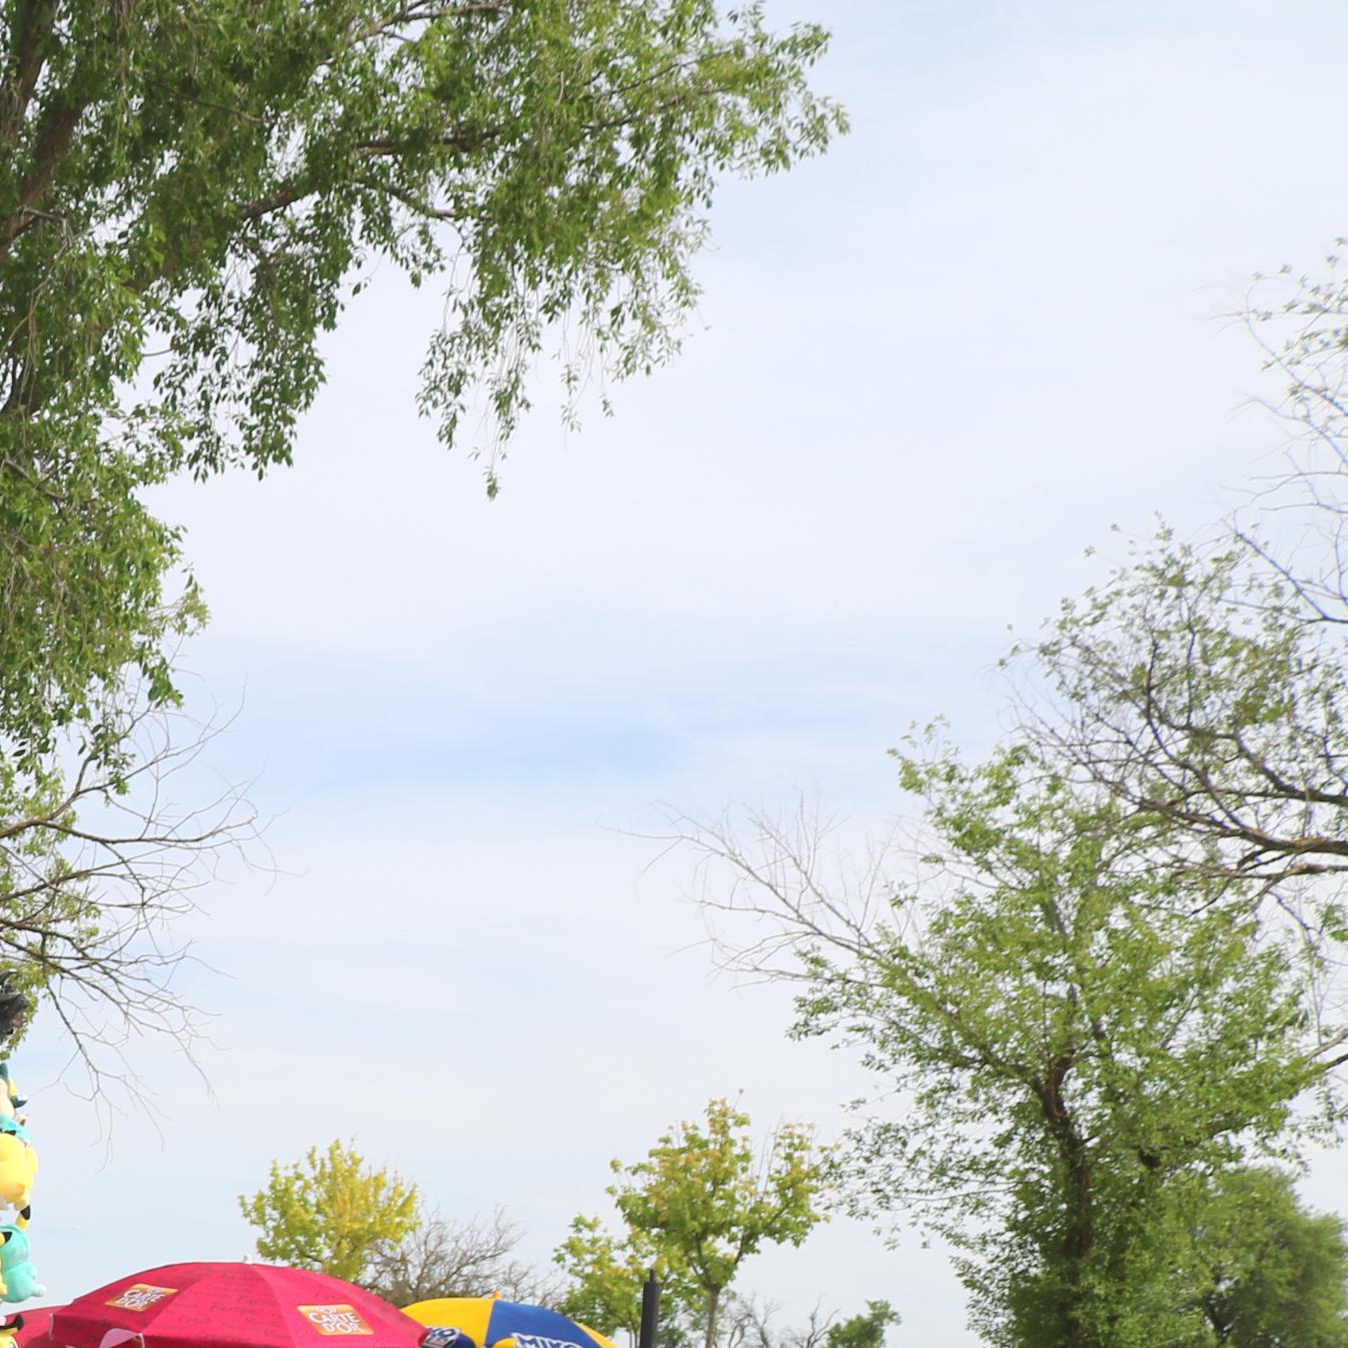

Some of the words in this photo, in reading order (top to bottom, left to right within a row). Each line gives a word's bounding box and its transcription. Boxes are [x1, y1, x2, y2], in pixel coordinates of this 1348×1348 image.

[123, 1289, 166, 1304] CARTE
[308, 1311, 360, 1326] CARTE
[324, 1321, 362, 1334] D'OR
